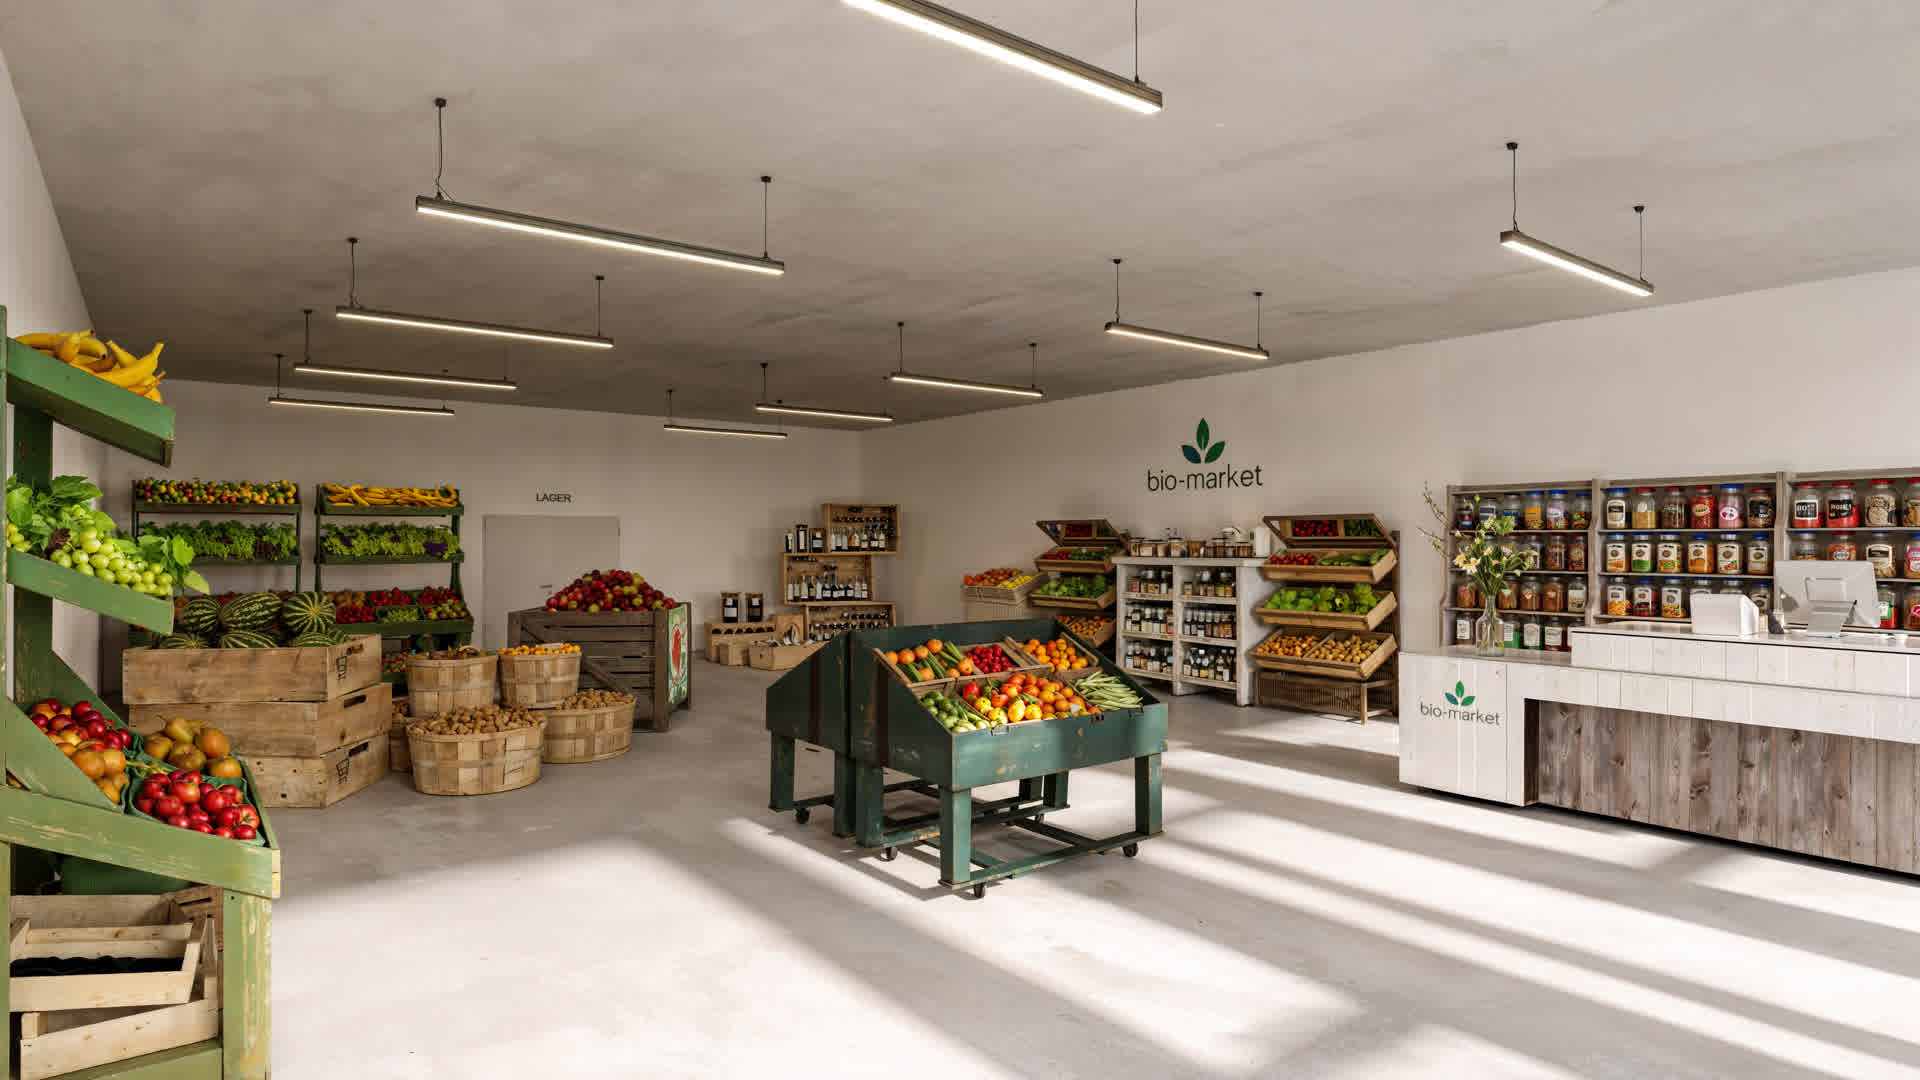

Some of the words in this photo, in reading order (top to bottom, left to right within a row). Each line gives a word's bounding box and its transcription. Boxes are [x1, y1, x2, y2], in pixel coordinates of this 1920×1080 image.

[1147, 463, 1263, 492] bio-market
[536, 493, 571, 503] LAGER
[1420, 701, 1499, 725] bio-market
